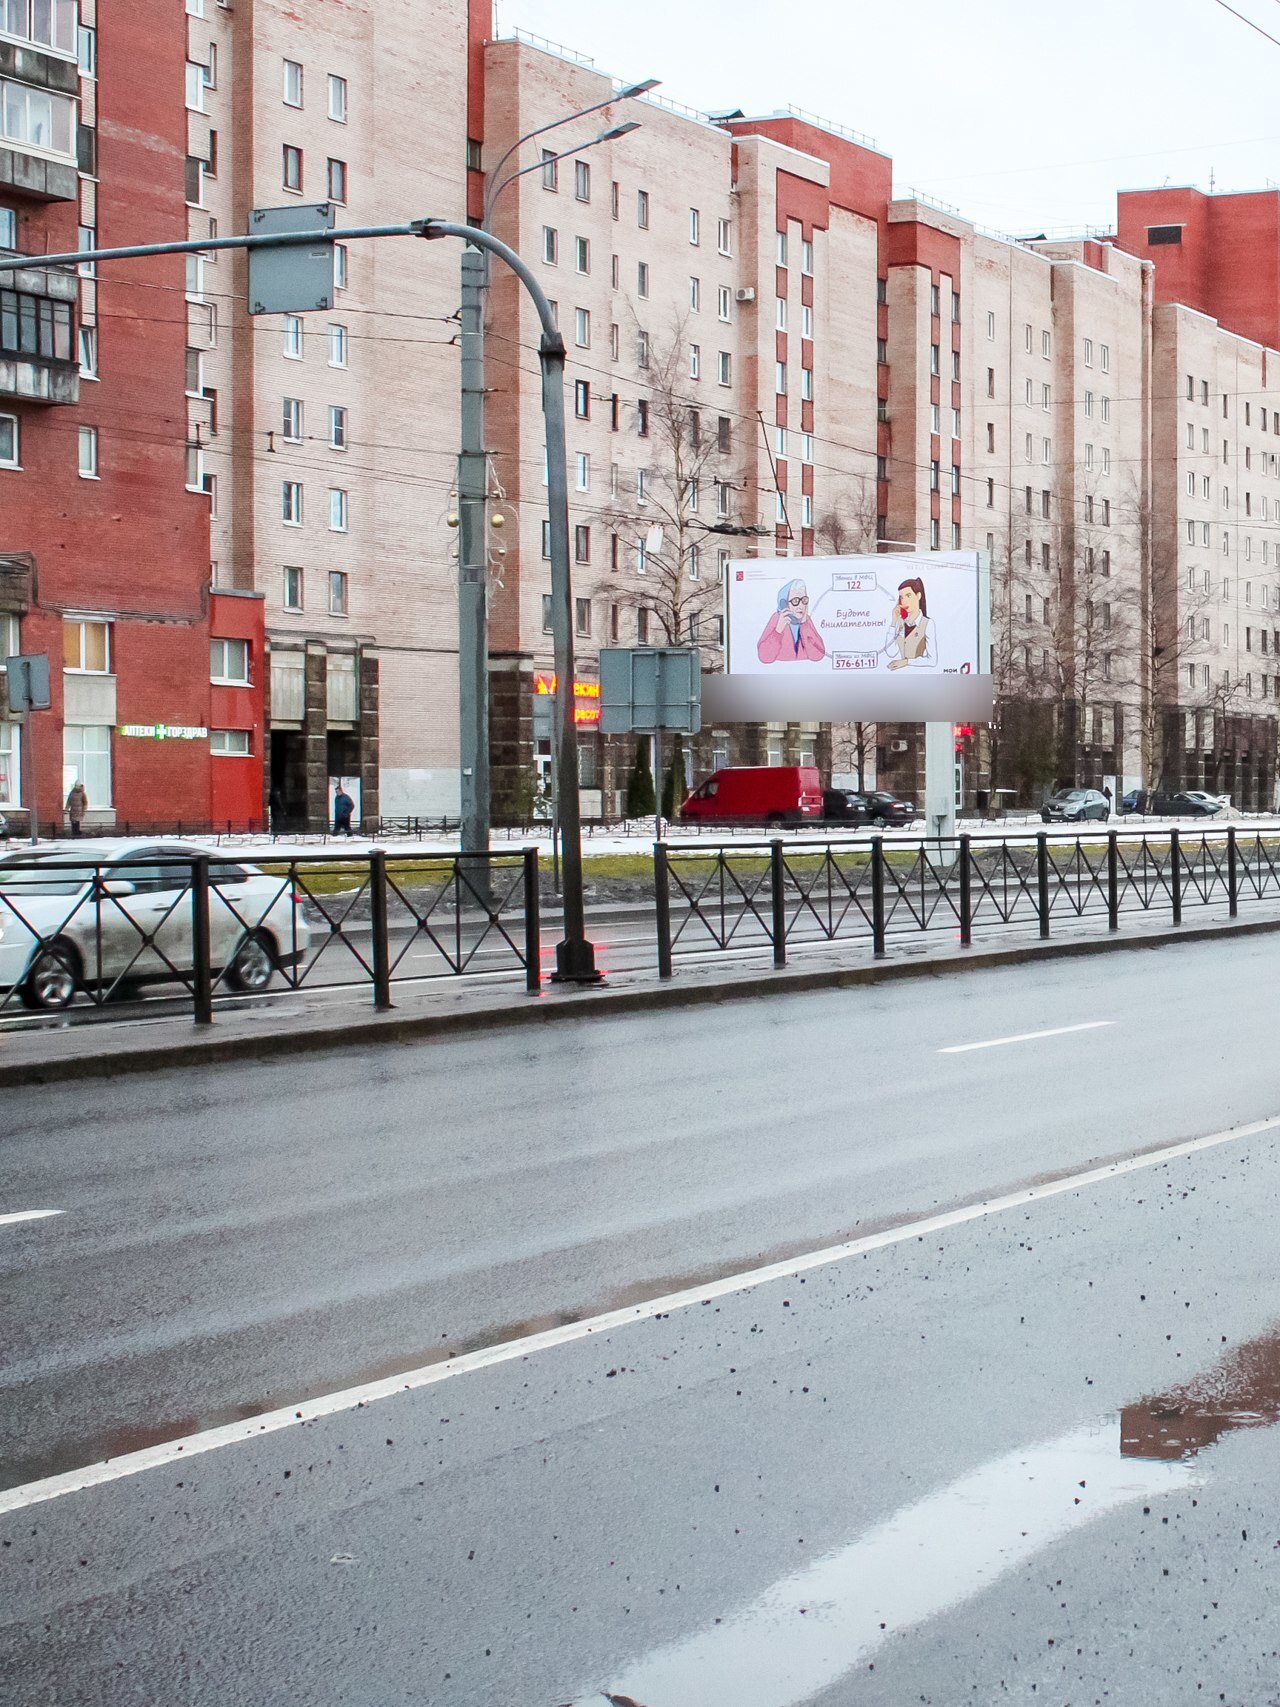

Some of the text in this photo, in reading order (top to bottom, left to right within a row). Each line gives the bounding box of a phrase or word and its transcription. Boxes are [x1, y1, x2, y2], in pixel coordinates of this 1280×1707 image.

[848, 580, 861, 590] 122
[836, 608, 870, 620] Будьте
[820, 618, 886, 628] внимательны!
[836, 660, 875, 668] 576-61-11
[124, 725, 208, 740] АПТЕКИ ГОРЗДРАВ
